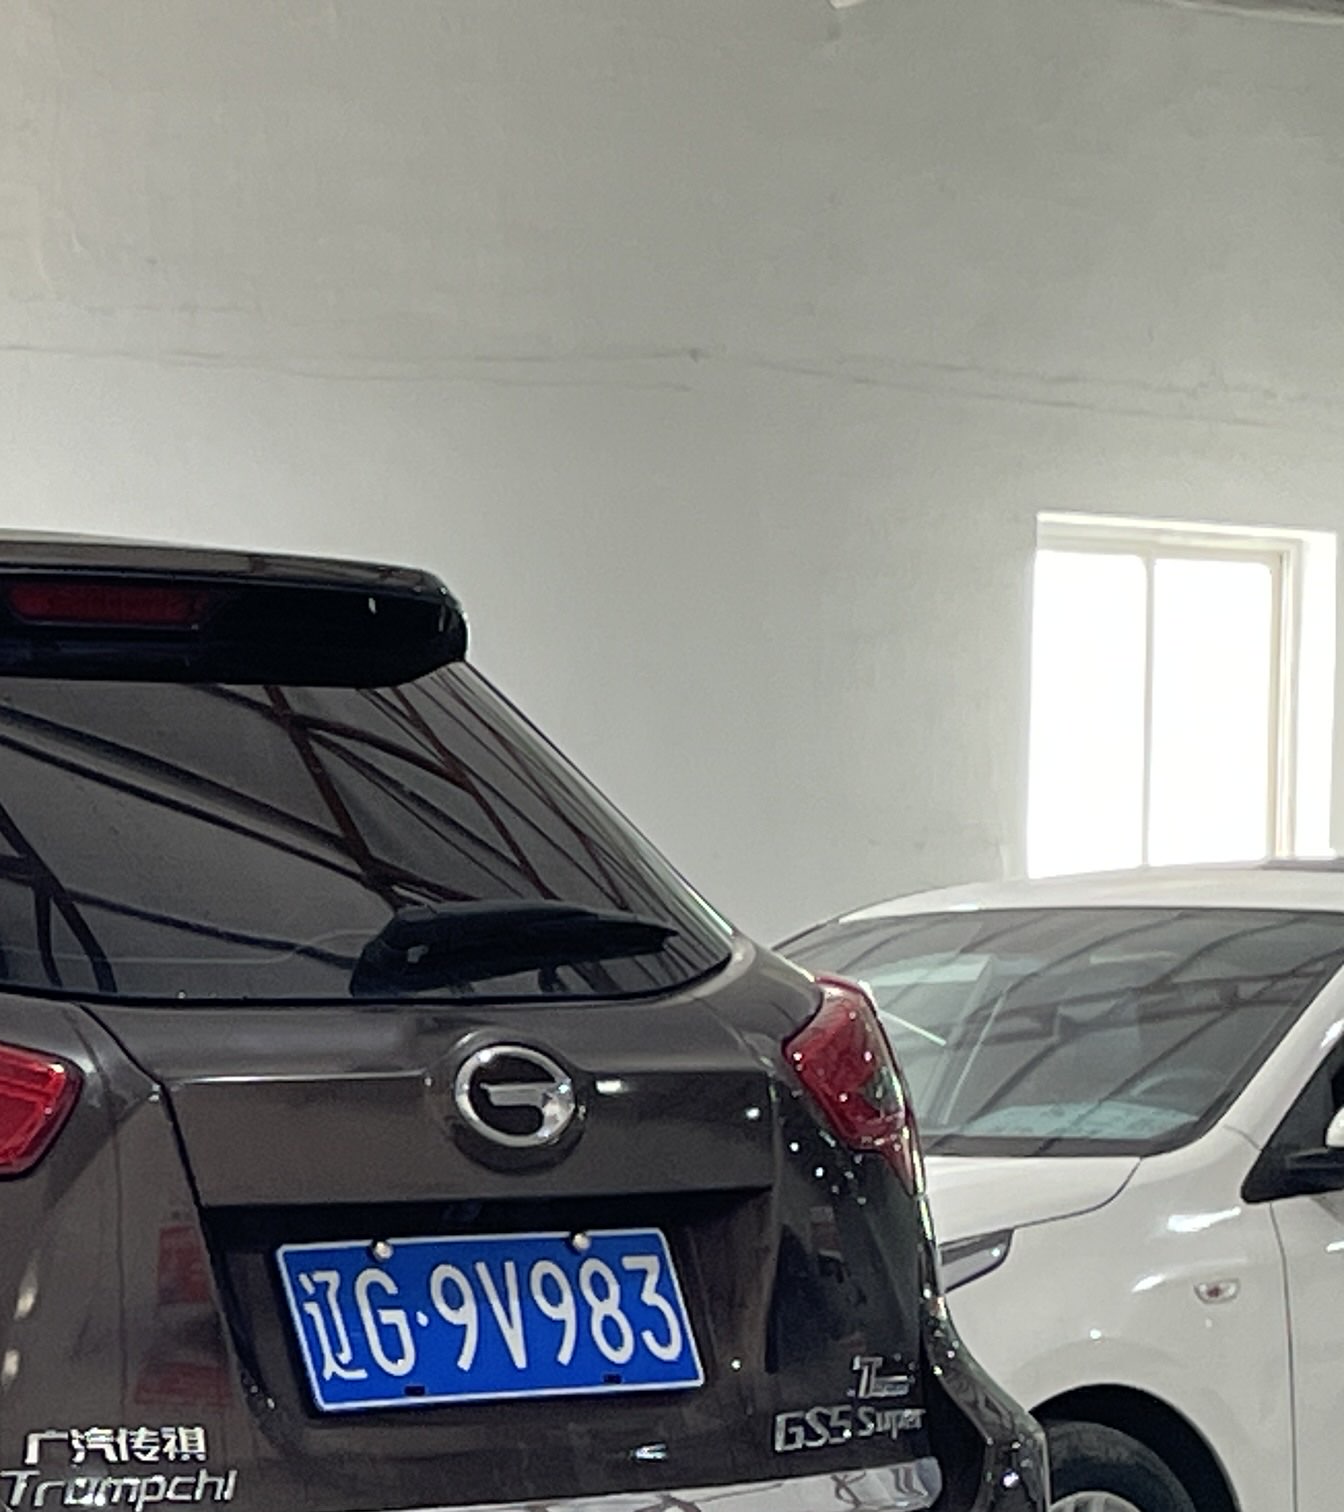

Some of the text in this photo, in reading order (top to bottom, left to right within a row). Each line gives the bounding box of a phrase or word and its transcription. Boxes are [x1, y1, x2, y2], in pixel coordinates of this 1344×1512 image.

[299, 1255, 683, 1381] 辽G·9V983
[24, 1426, 207, 1465] 广汽传祺
[774, 1404, 927, 1452] GS5 Super
[0, 1467, 238, 1512] Trumpchi
